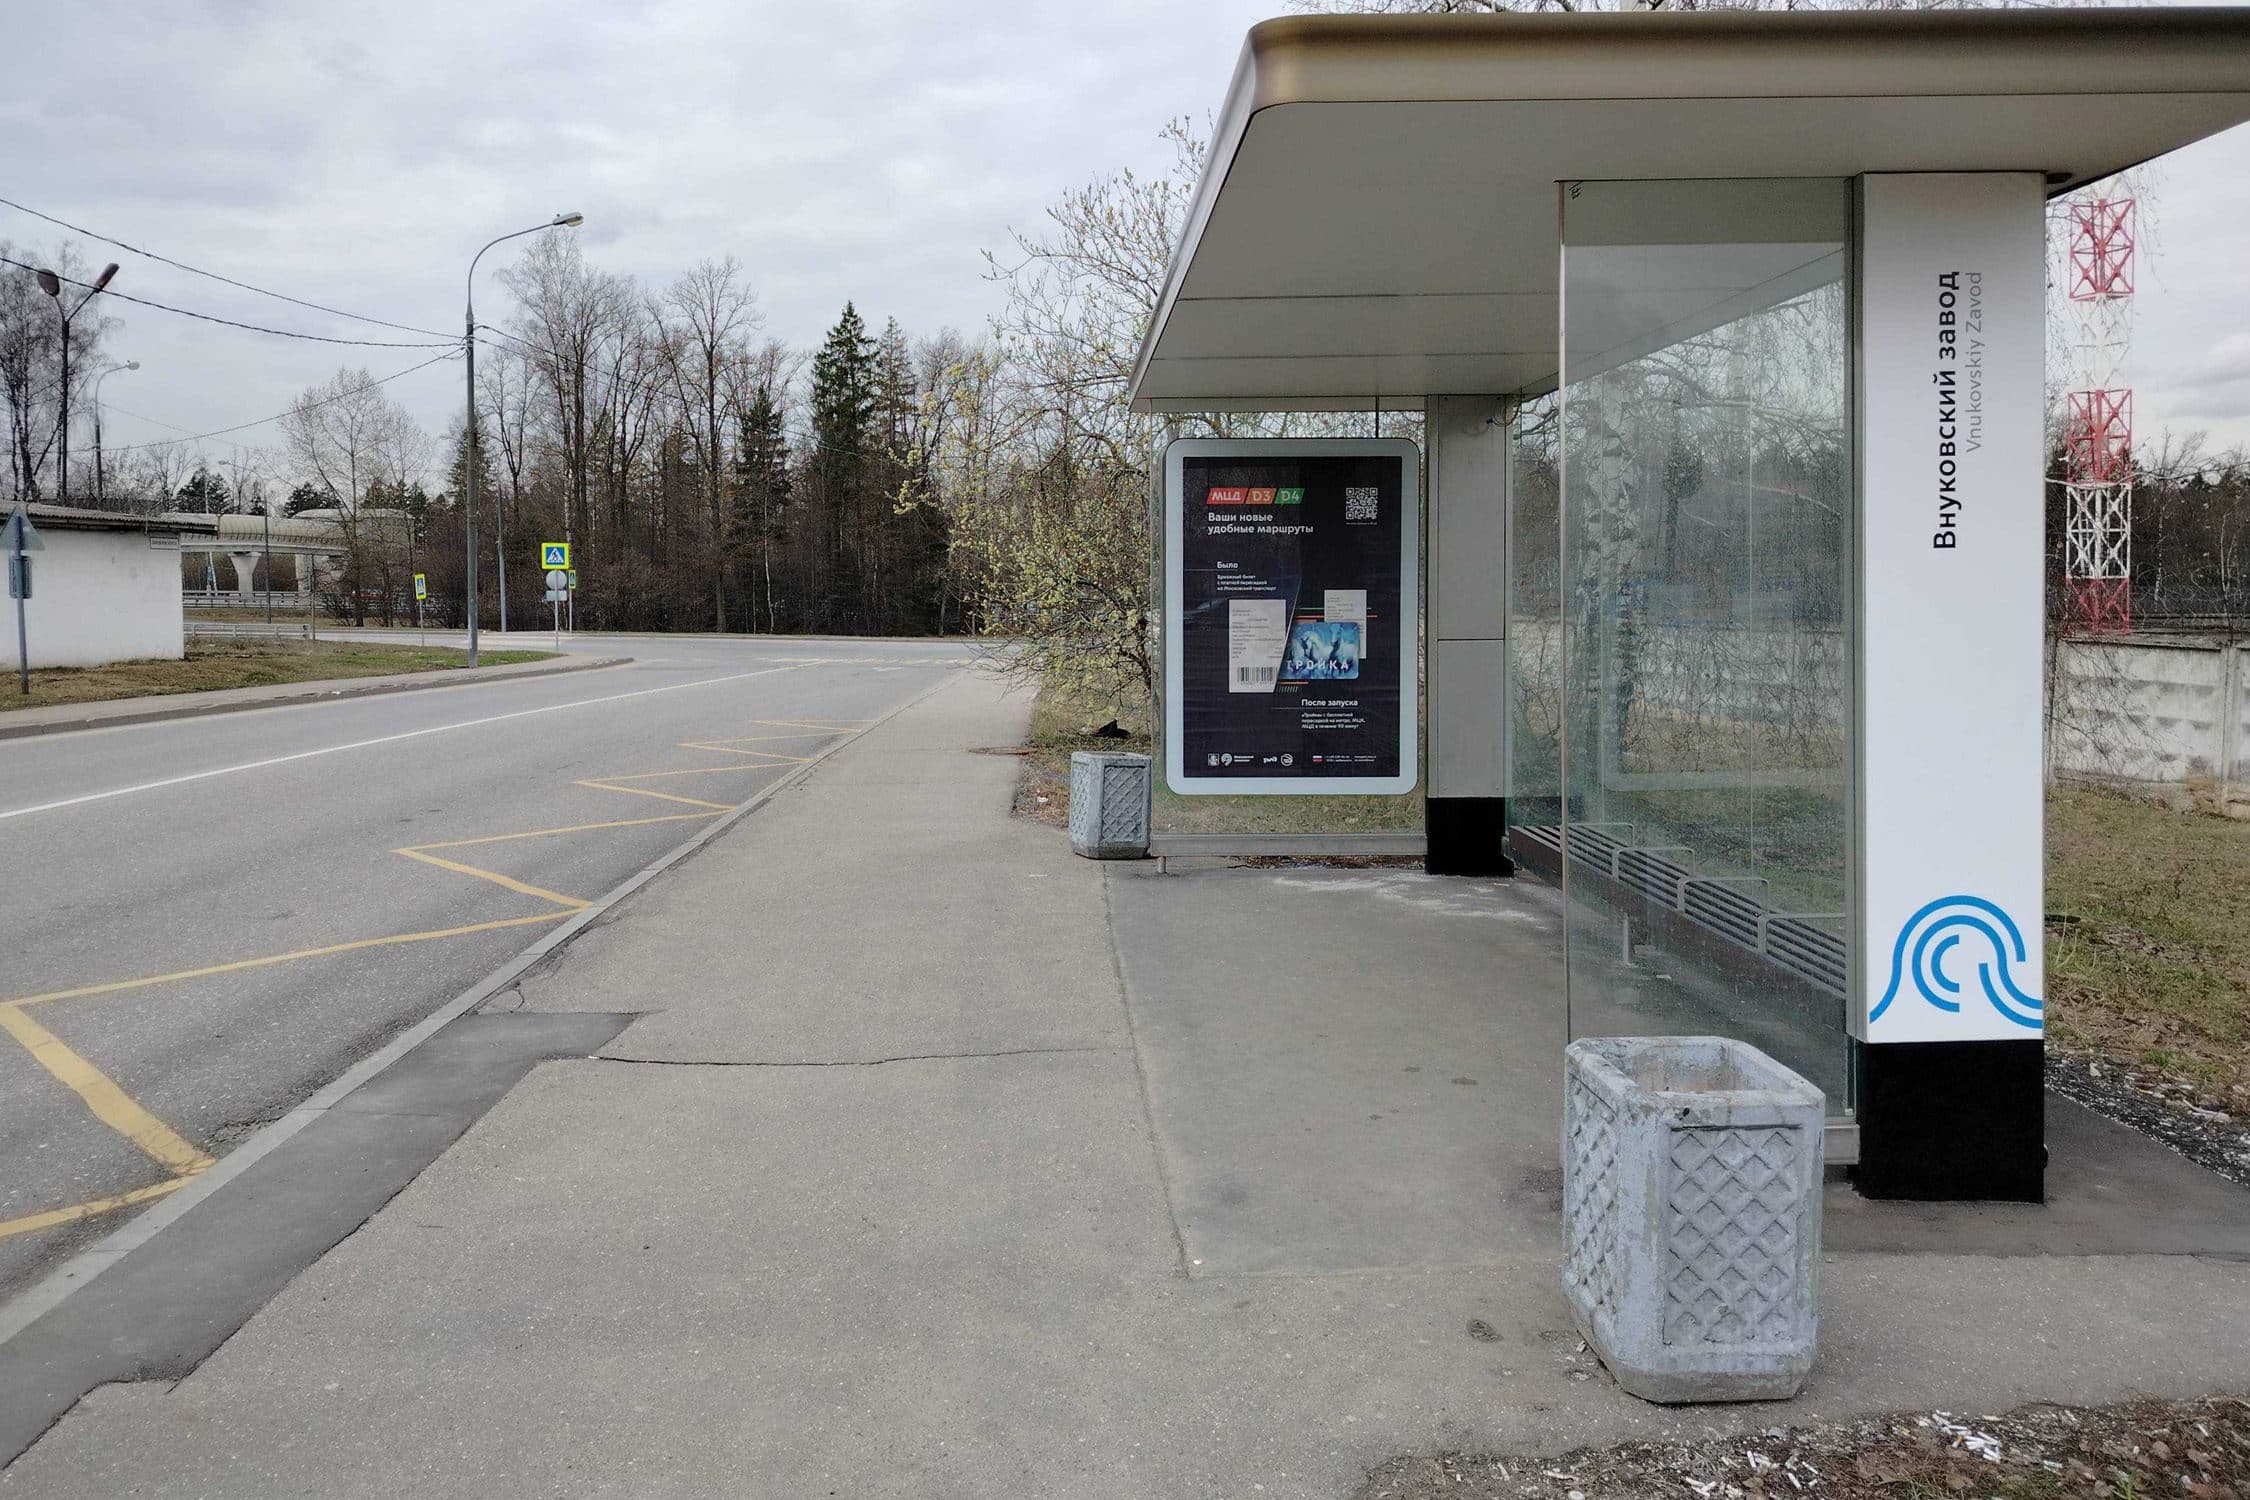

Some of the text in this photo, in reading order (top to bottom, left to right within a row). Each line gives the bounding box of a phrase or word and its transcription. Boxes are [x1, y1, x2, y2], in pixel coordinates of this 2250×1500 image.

[1965, 272, 1986, 452] Vnukovskiy Zavod
[1933, 271, 1962, 549] Внуковский завод
[1212, 491, 1299, 501] МЦД D3 D4
[1208, 512, 1273, 522] Ваши новые
[1207, 524, 1313, 535] удобные маршруты
[1217, 561, 1238, 569] Было
[1328, 700, 1358, 708] запуска
